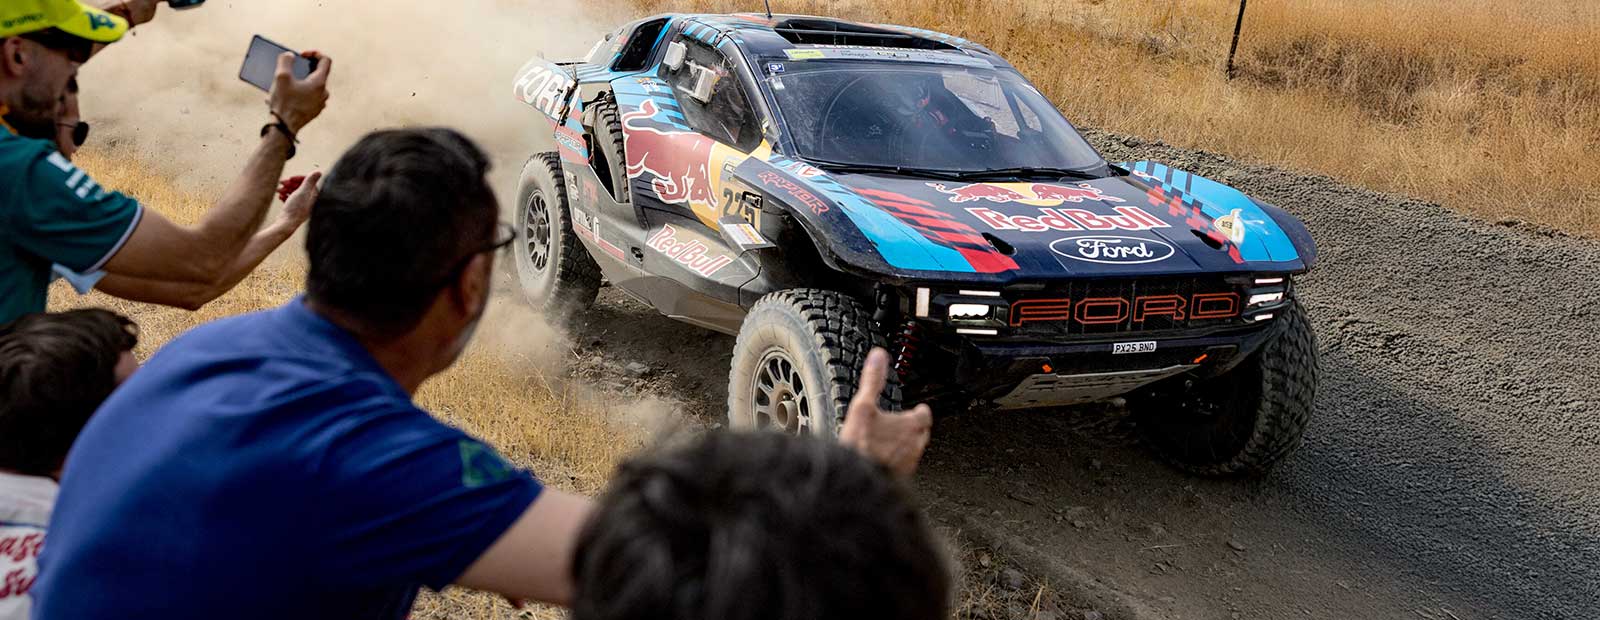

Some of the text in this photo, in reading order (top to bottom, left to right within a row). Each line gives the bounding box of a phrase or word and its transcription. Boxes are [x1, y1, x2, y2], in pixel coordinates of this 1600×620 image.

[757, 170, 830, 216] RAPTOR
[1076, 238, 1154, 259] Ford
[1010, 292, 1241, 327] FORD
